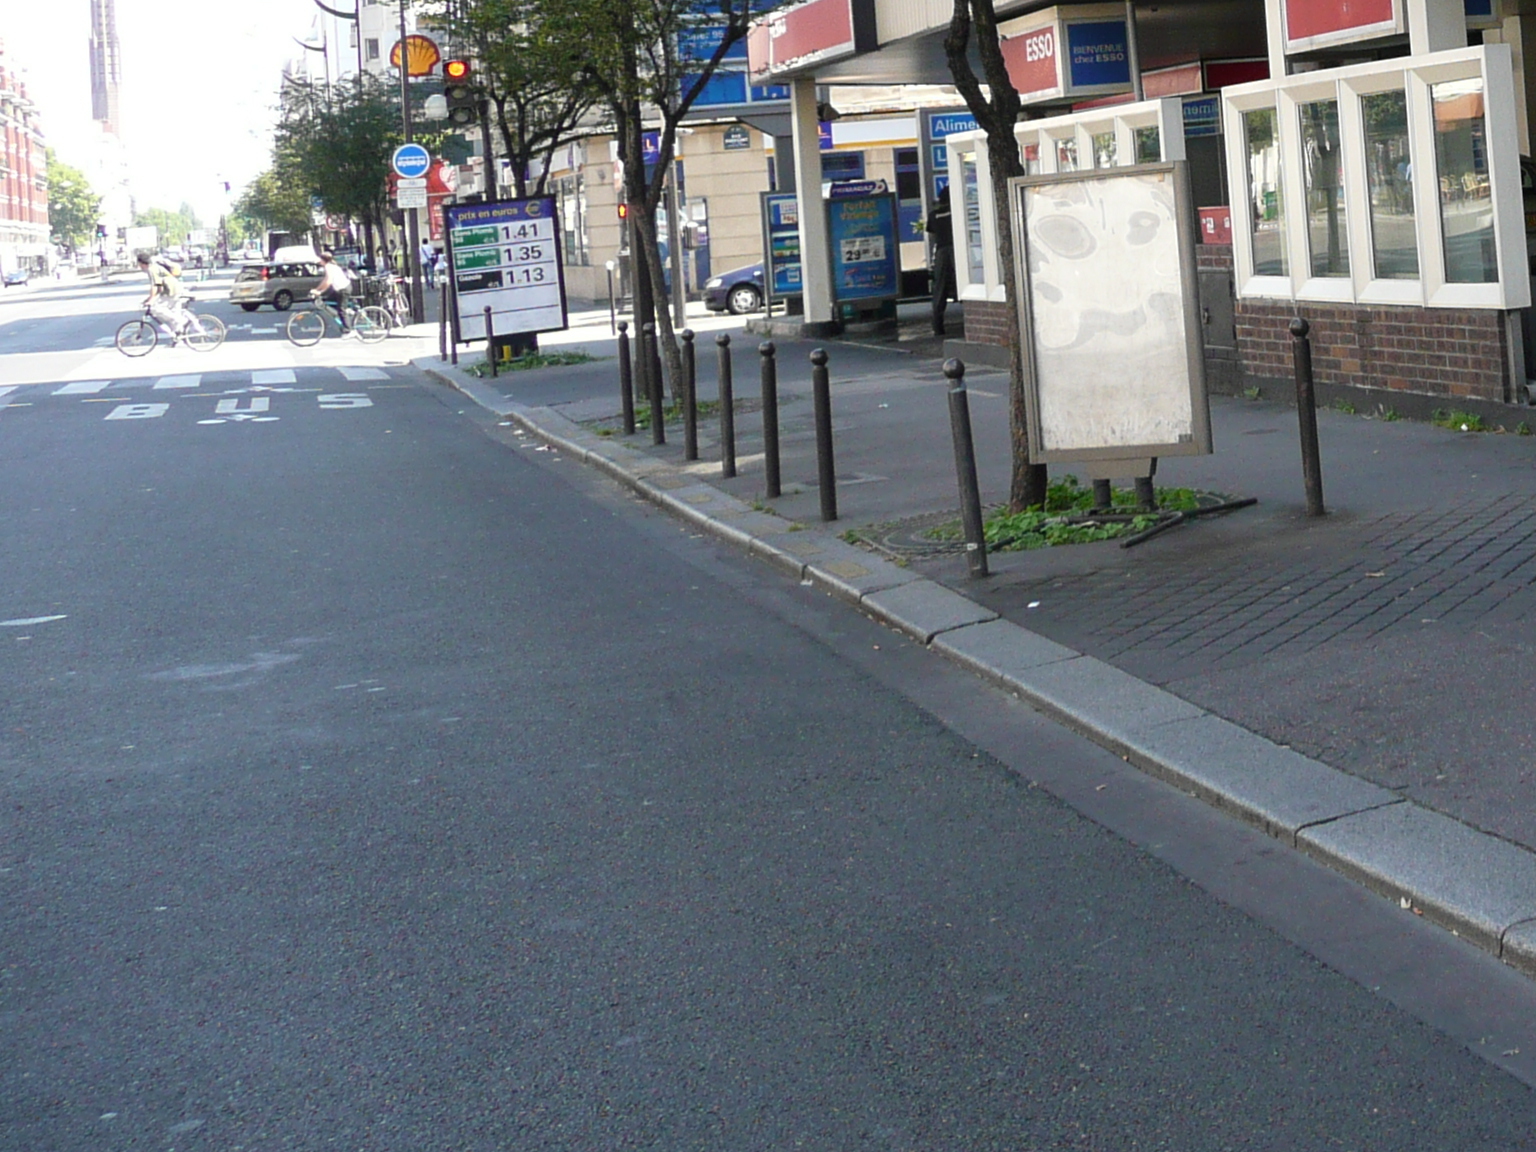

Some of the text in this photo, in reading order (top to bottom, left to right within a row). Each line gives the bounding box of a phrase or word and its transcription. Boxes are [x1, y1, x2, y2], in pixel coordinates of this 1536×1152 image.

[1026, 33, 1053, 62] ESSO
[1073, 43, 1124, 54] BIENVENUE
[1074, 53, 1125, 64] chez ESSO
[458, 211, 476, 221] prix
[492, 208, 518, 217] euros
[501, 223, 539, 240] 1.41
[503, 245, 543, 263] 1.35
[506, 267, 545, 285] 1.13
